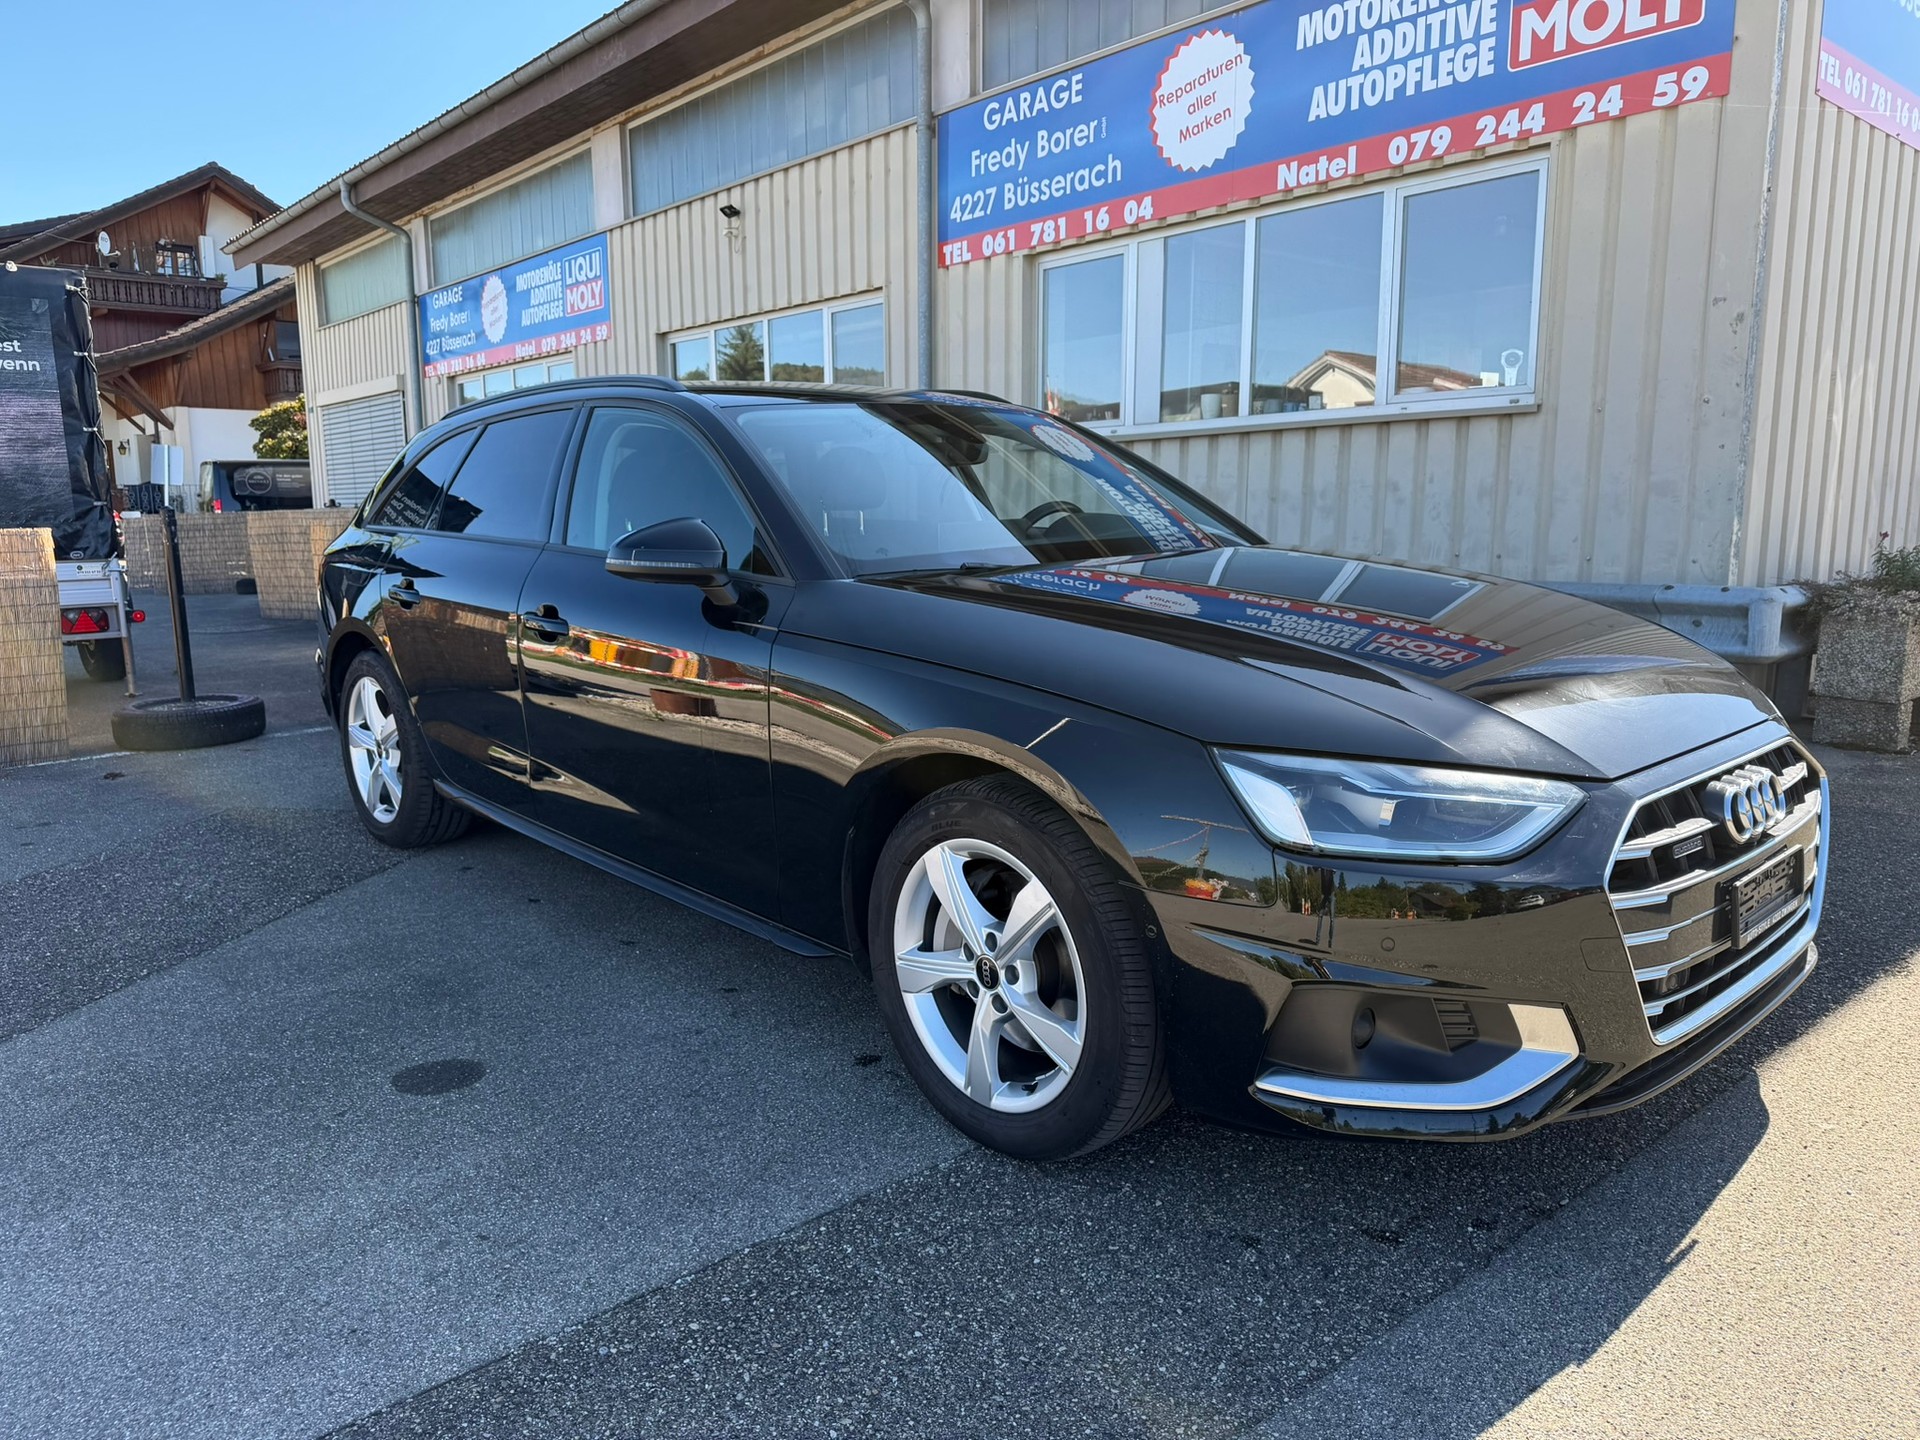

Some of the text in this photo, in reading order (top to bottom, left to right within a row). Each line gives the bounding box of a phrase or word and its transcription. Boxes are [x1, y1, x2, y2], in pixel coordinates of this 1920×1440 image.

[1296, 0, 1457, 51] MOTORE
[1352, 0, 1497, 72] ADDITIVE
[1158, 53, 1243, 109] Reparaturen
[1308, 36, 1496, 122] AUTOPFLEGE
[1820, 50, 1920, 132] TEL 061 781 16 0
[983, 72, 1083, 131] GARAGE
[1187, 91, 1217, 115] aller
[1179, 107, 1232, 144] Marken
[1277, 65, 1709, 190] Natel 079 244 24 59
[971, 119, 1098, 177] Fredy Borer
[950, 153, 1122, 223] 4227 Büsserach
[943, 196, 1153, 266] TEL 061 781 16 04
[516, 260, 561, 293] MOTORENÖLE
[565, 251, 600, 285] LIQUI
[432, 286, 463, 309] GARAGE
[530, 281, 562, 306] ADDITIVE
[566, 280, 602, 313] MOLY
[430, 315, 448, 333] Fredy
[521, 300, 563, 327] AUTOPFLEGE
[0, 340, 22, 353] st
[515, 325, 608, 357] Natel 079 244 24 59
